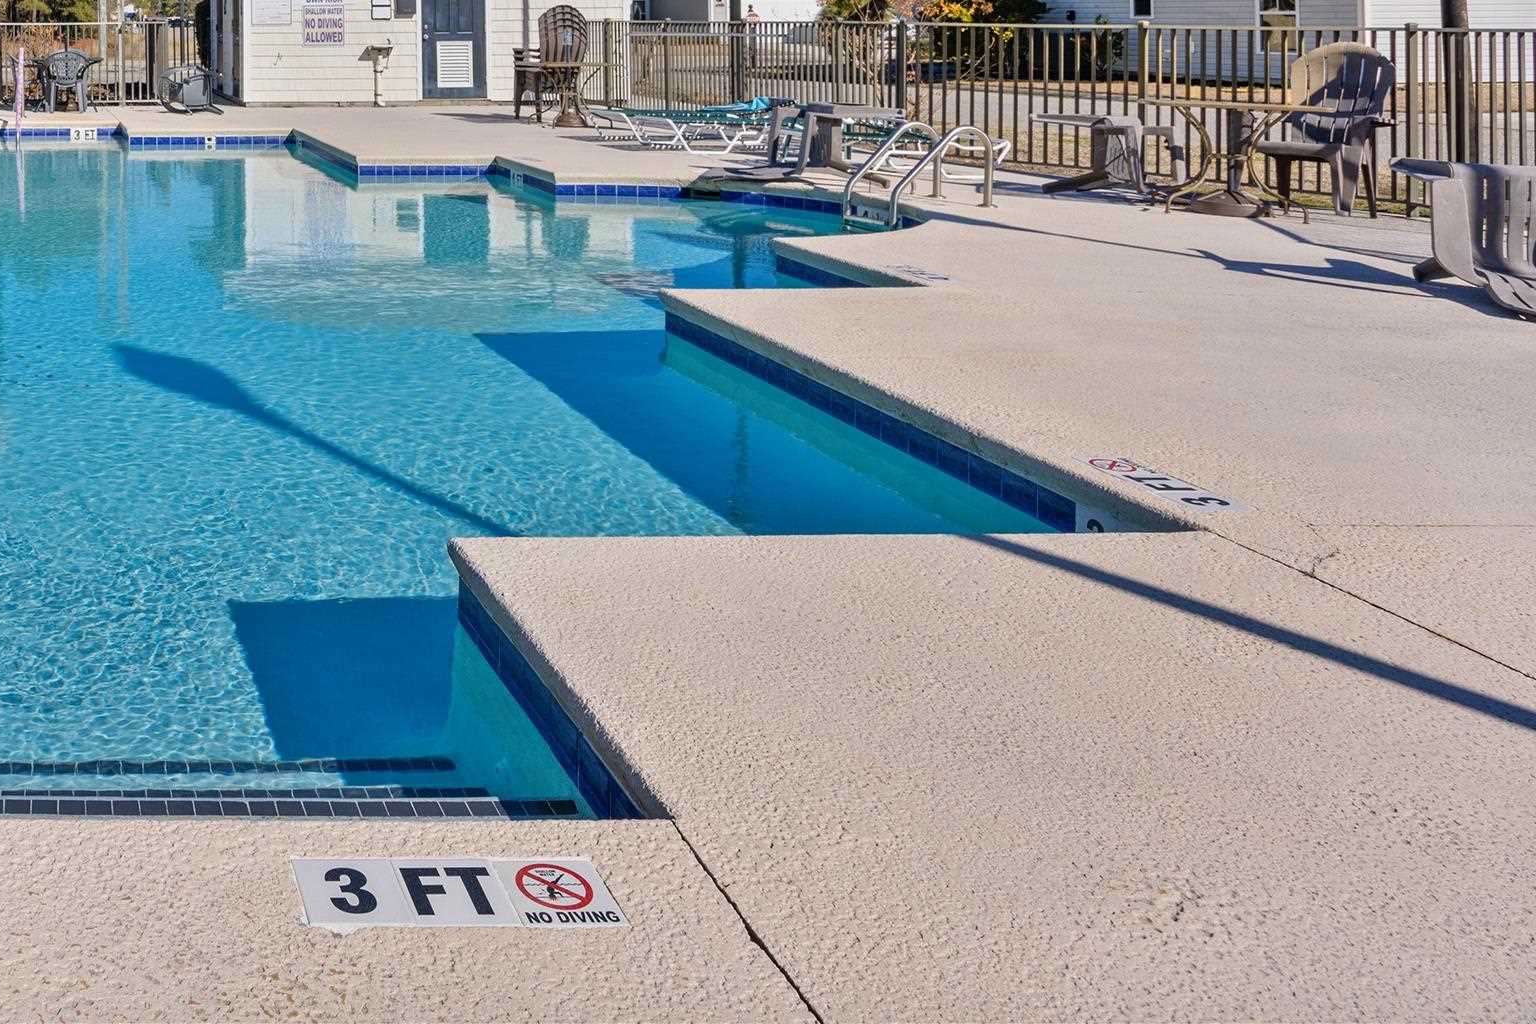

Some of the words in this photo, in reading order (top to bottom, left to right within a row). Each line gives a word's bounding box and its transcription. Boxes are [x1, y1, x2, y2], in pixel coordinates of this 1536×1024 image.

[305, 18, 316, 29] NO
[318, 18, 343, 29] DIVING
[305, 32, 343, 43] ALLOWED
[1122, 474, 1198, 491] FT
[1181, 496, 1231, 507] 3
[323, 867, 378, 914] 3
[398, 867, 496, 916] FT
[525, 911, 553, 923] NO
[555, 911, 621, 923] DIVING
